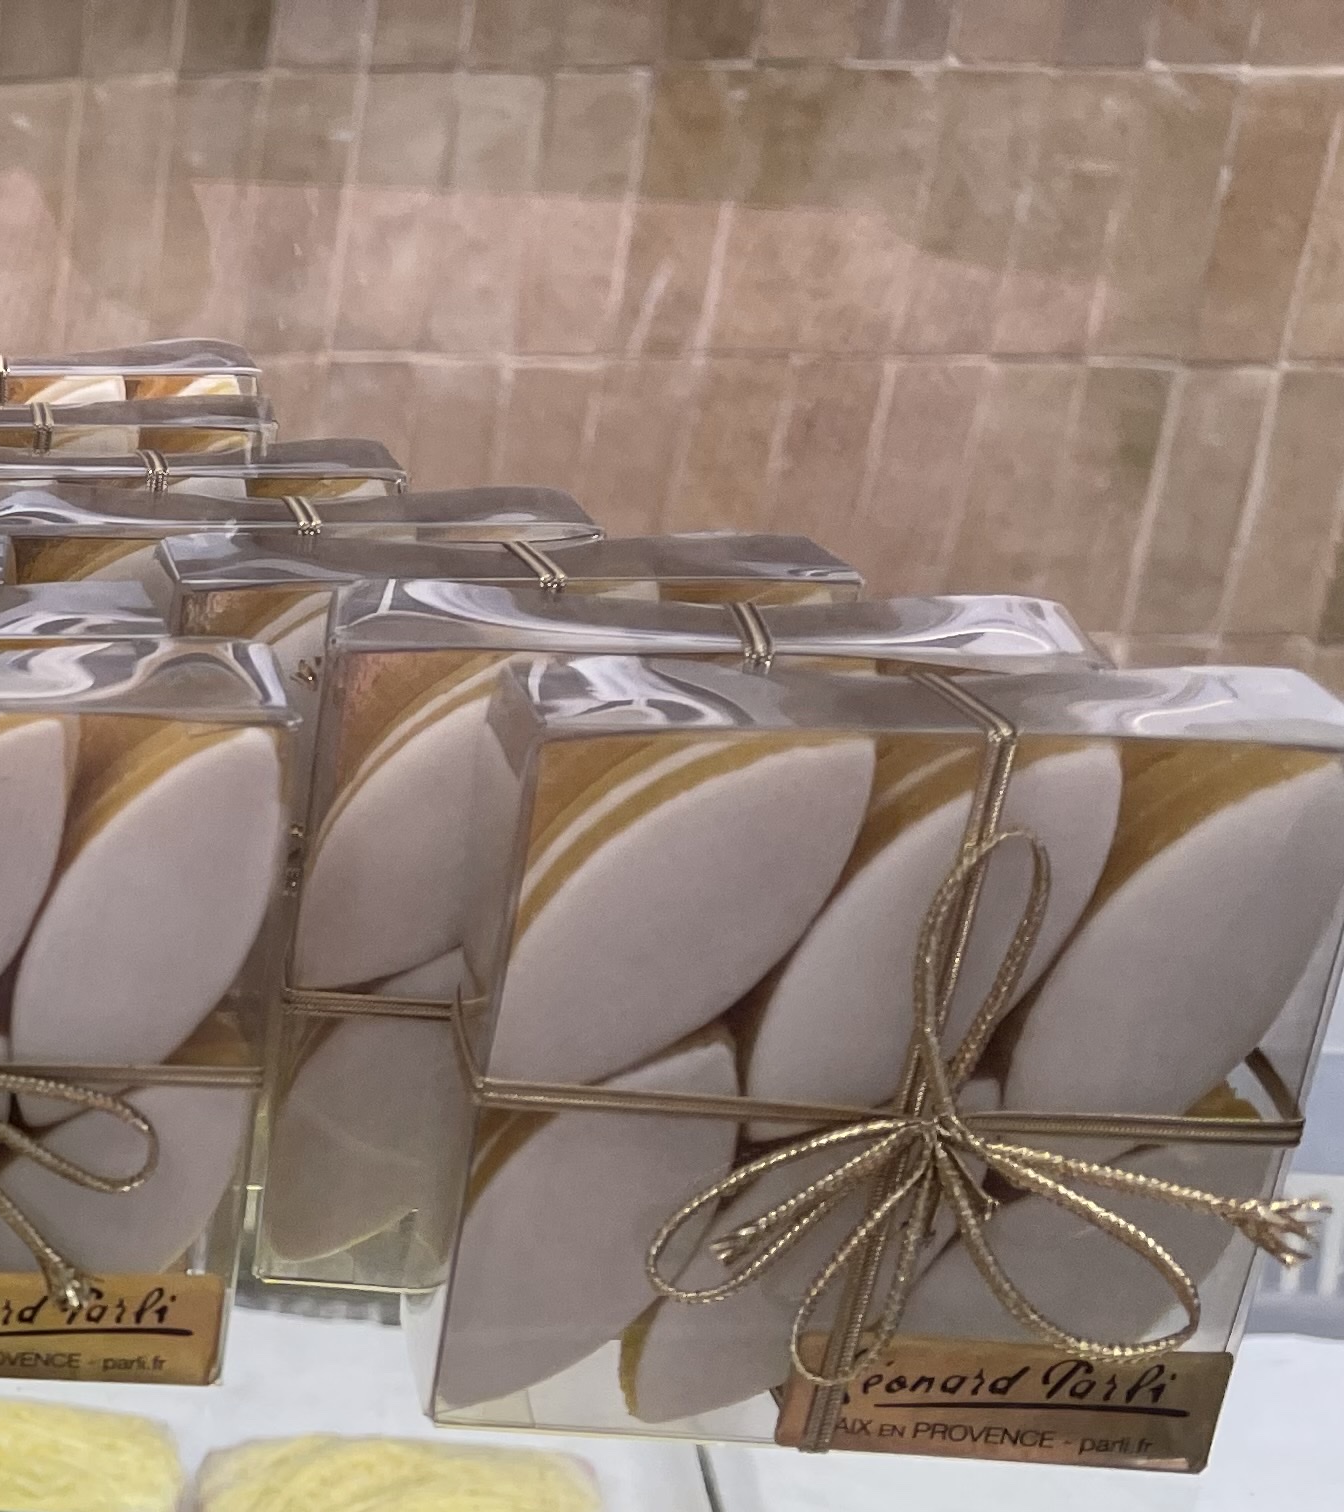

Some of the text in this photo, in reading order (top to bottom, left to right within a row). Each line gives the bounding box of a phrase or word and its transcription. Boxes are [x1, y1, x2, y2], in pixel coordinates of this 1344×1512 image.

[834, 1417, 872, 1435] AIX
[878, 1423, 907, 1437] EN
[912, 1422, 1057, 1449] PROVENCE
